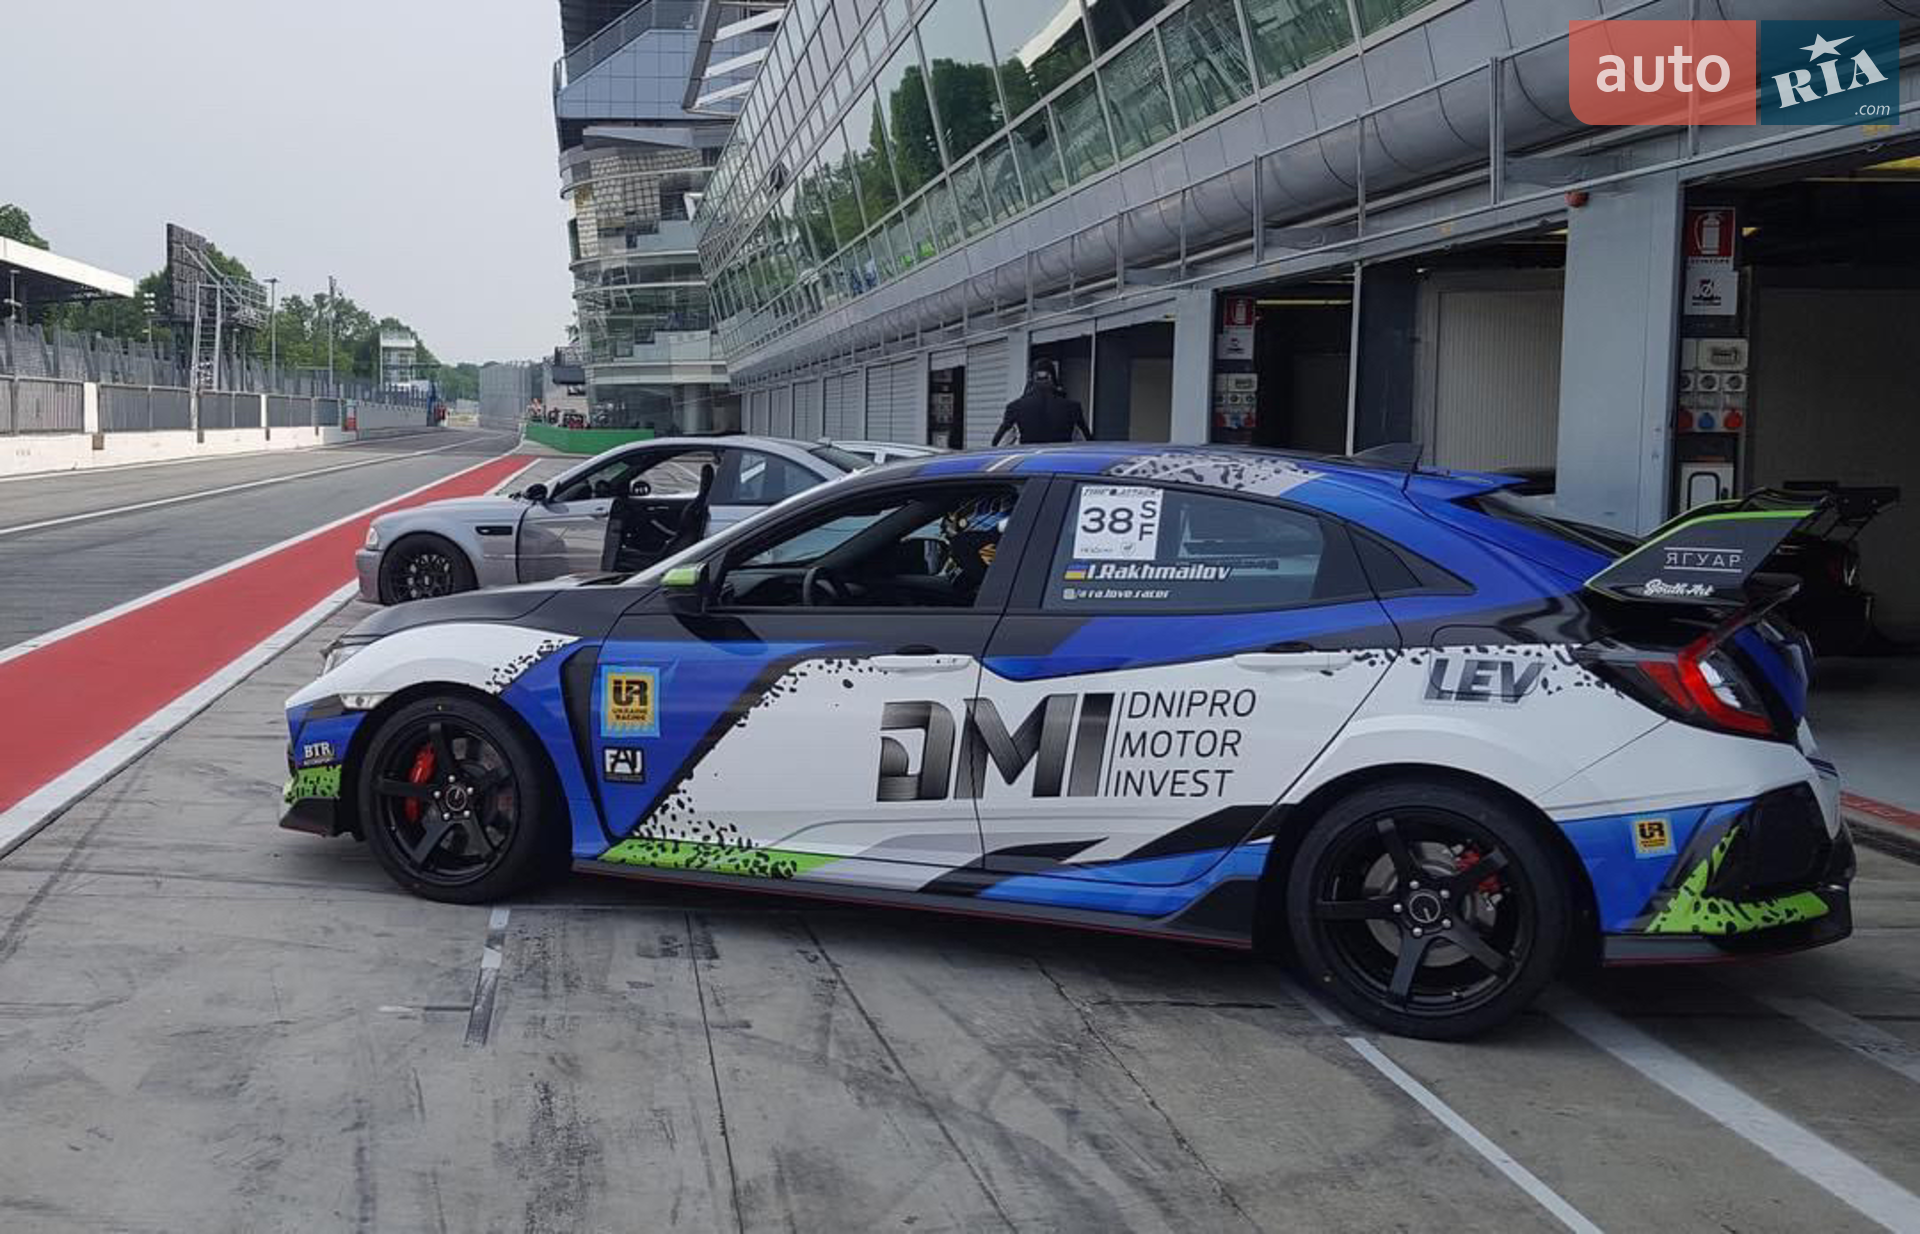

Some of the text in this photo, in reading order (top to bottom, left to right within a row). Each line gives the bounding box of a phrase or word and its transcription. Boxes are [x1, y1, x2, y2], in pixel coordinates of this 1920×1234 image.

[1081, 507, 1134, 534] 38
[1140, 500, 1157, 519] S
[1138, 523, 1155, 541] F
[1665, 552, 1741, 567] ЯГУАР
[1424, 658, 1547, 703] LEV
[1127, 688, 1257, 719] DNIPRO
[304, 741, 331, 758] BTR
[1119, 729, 1243, 759] MOTOR
[1113, 769, 1235, 798] INVEST
